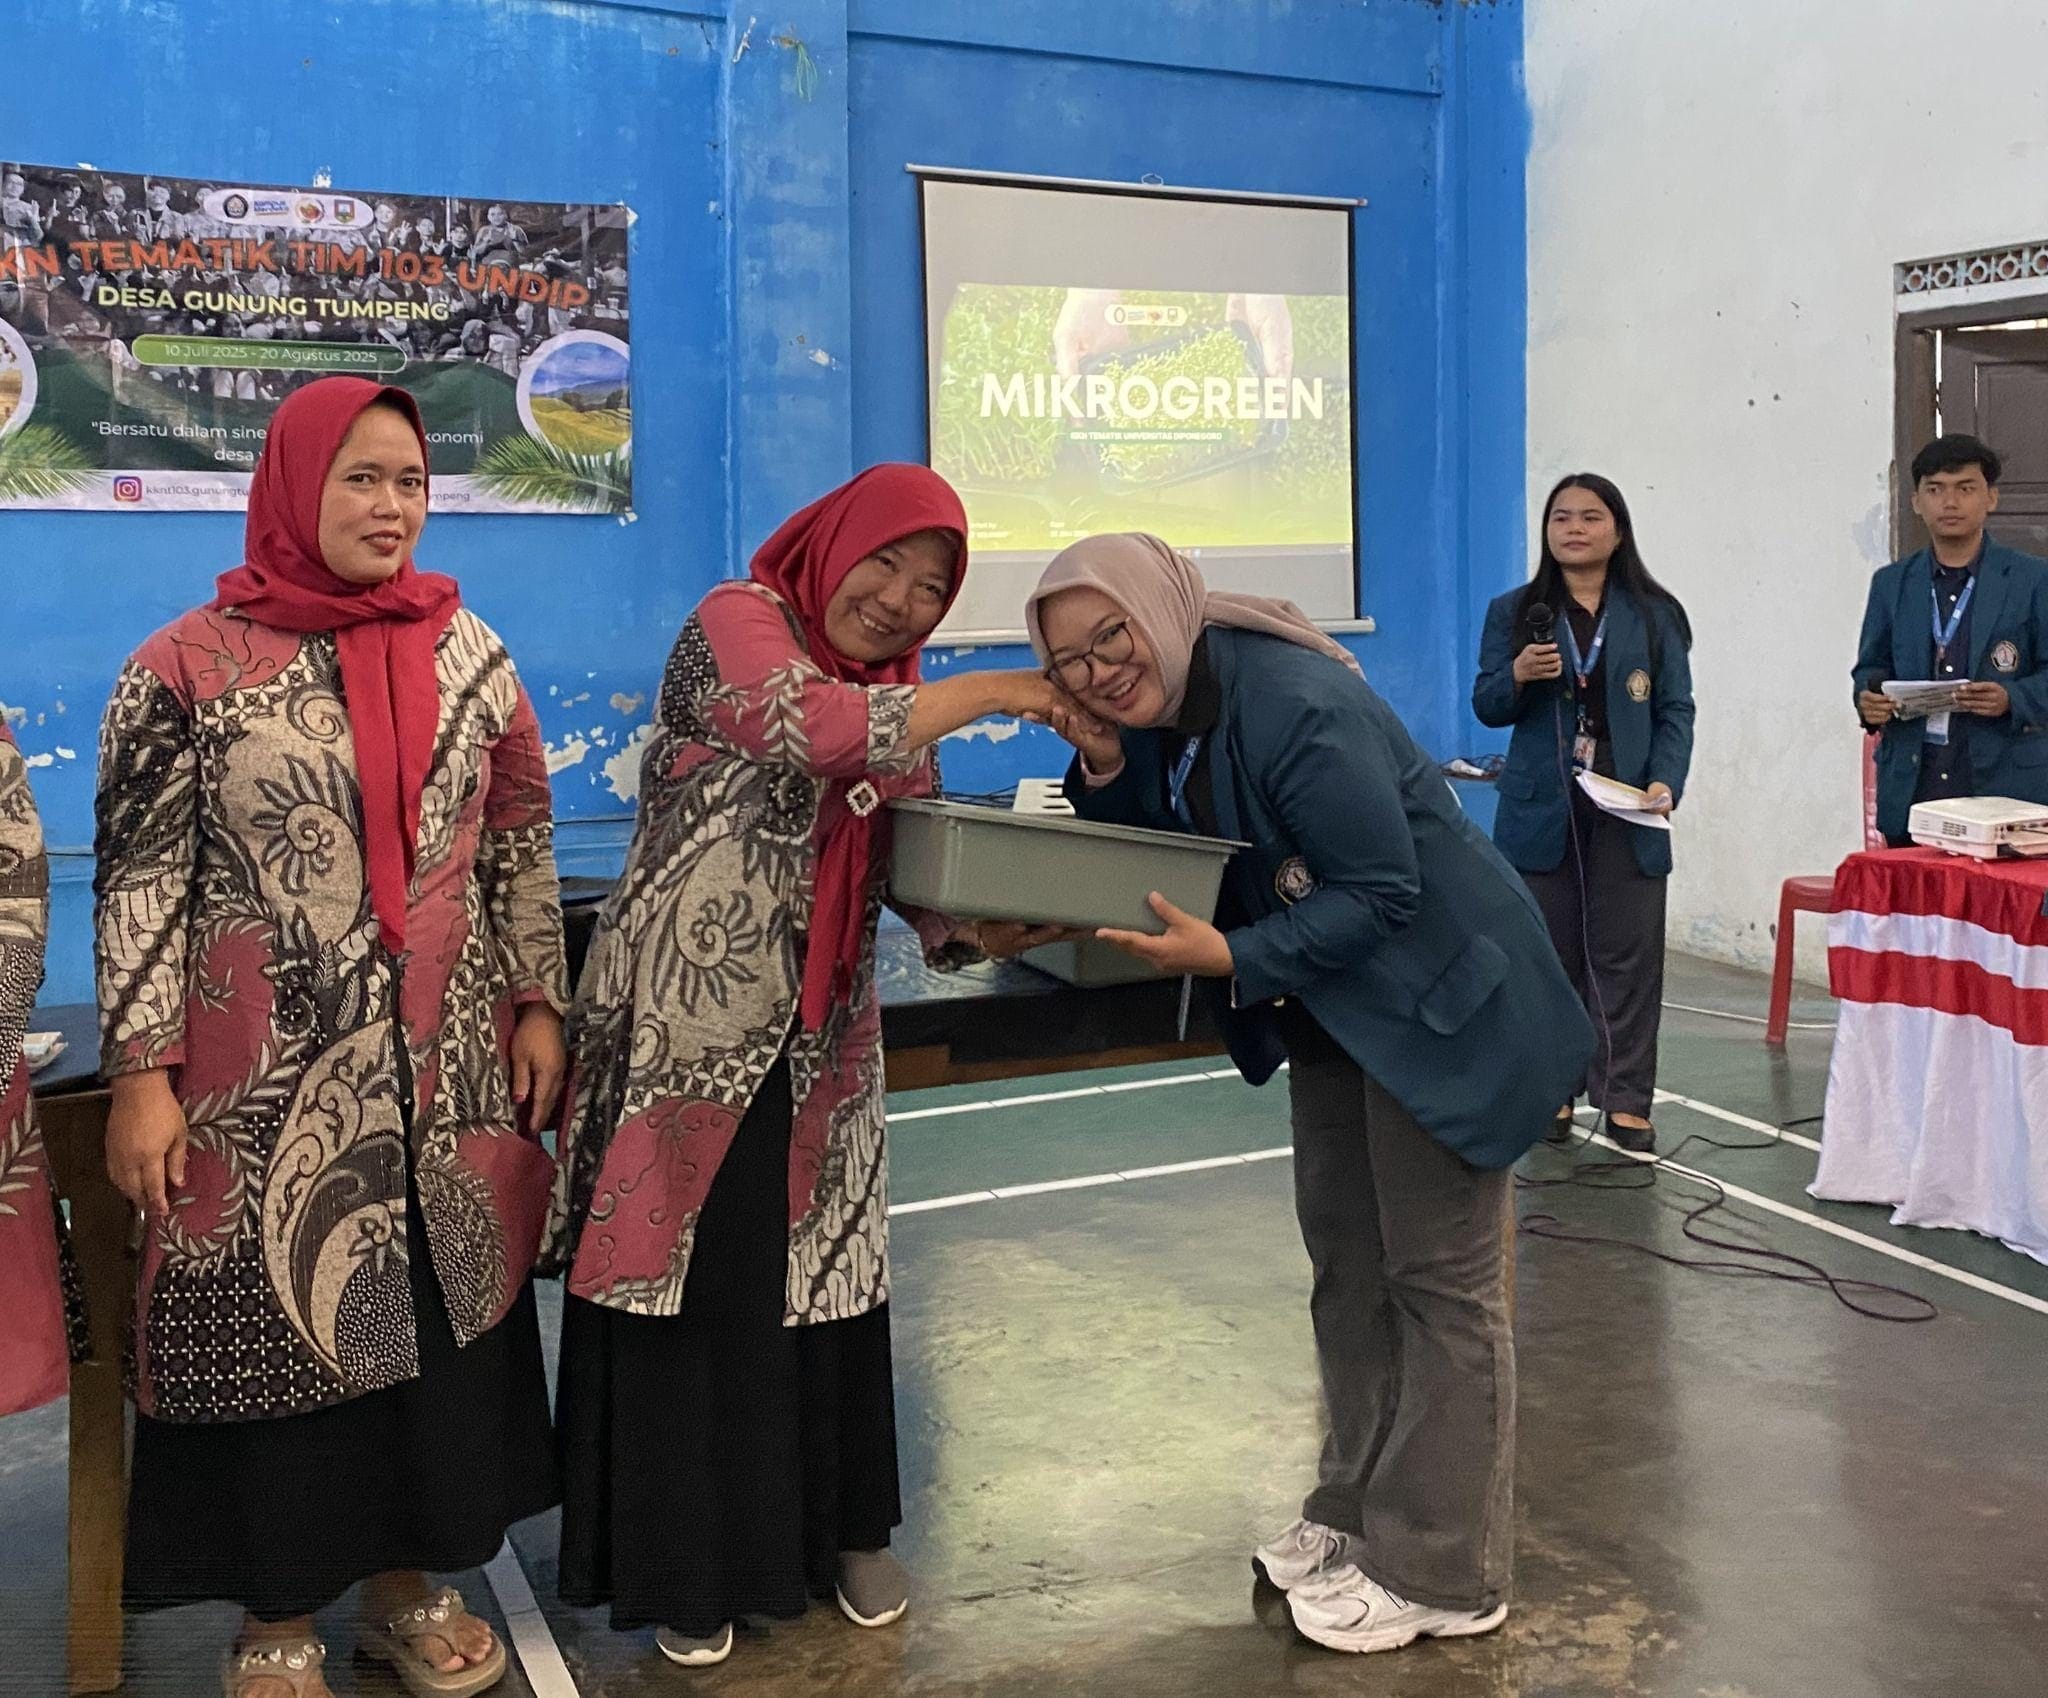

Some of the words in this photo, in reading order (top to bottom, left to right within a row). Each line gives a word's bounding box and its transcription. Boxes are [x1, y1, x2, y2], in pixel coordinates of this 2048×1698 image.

[68, 238, 278, 273] TEMATIK
[288, 239, 367, 278] TIM
[379, 247, 446, 287] 103
[456, 261, 591, 311] UNDIP
[98, 285, 177, 309] DESA
[184, 290, 308, 316] GUNUNG
[314, 298, 450, 322] TUMPENG
[164, 344, 180, 357] 10
[183, 344, 208, 358] Juli
[212, 346, 248, 359] 2025
[260, 348, 279, 360] 20
[282, 349, 341, 364] Agustus
[343, 350, 377, 363] 2025
[980, 372, 1325, 421] MIKROGREEN
[173, 423, 228, 440] dalam
[214, 448, 254, 462] desa
